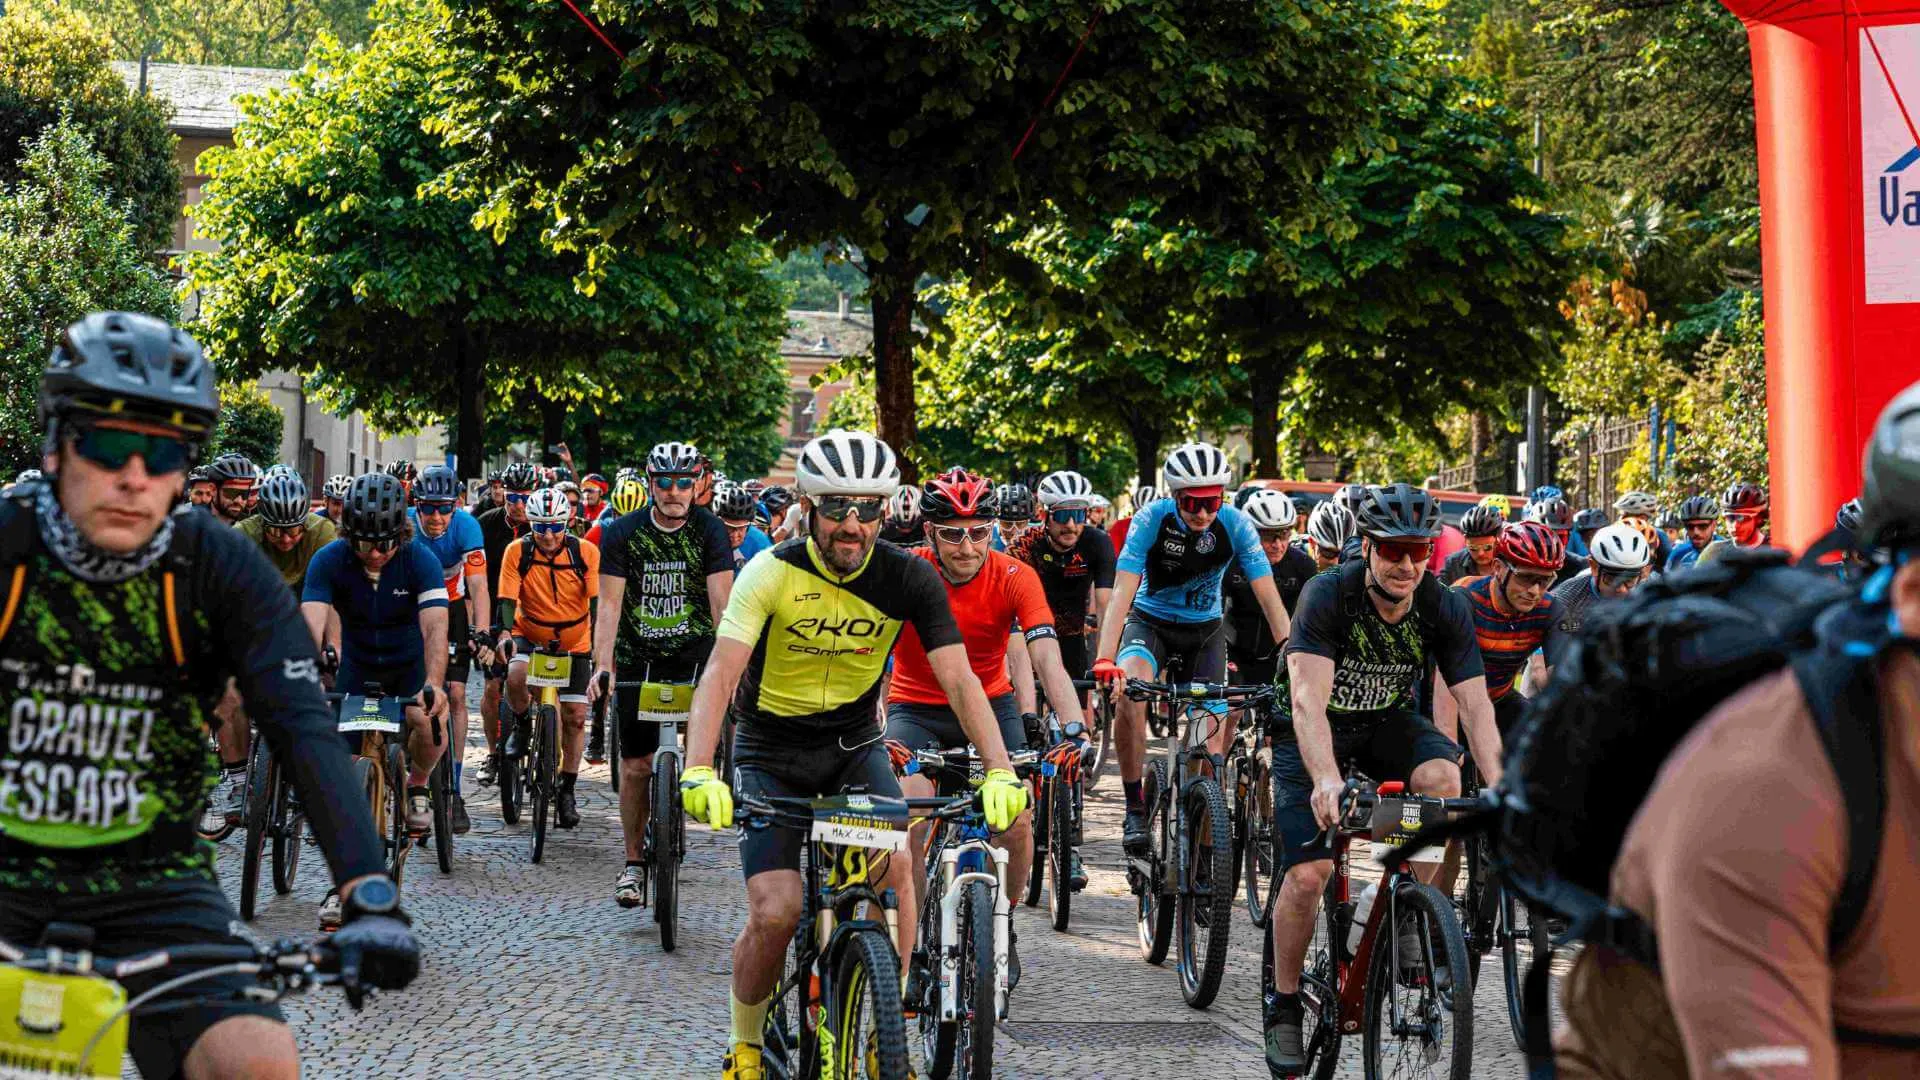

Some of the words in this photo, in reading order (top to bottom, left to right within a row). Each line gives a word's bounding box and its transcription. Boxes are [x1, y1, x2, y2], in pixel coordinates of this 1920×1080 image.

[642, 573, 687, 595] GRAVEL
[641, 595, 688, 619] ESCAPE
[794, 593, 821, 602] LTD
[8, 697, 156, 761] GRAVEL
[0, 759, 147, 829] ESCAPE
